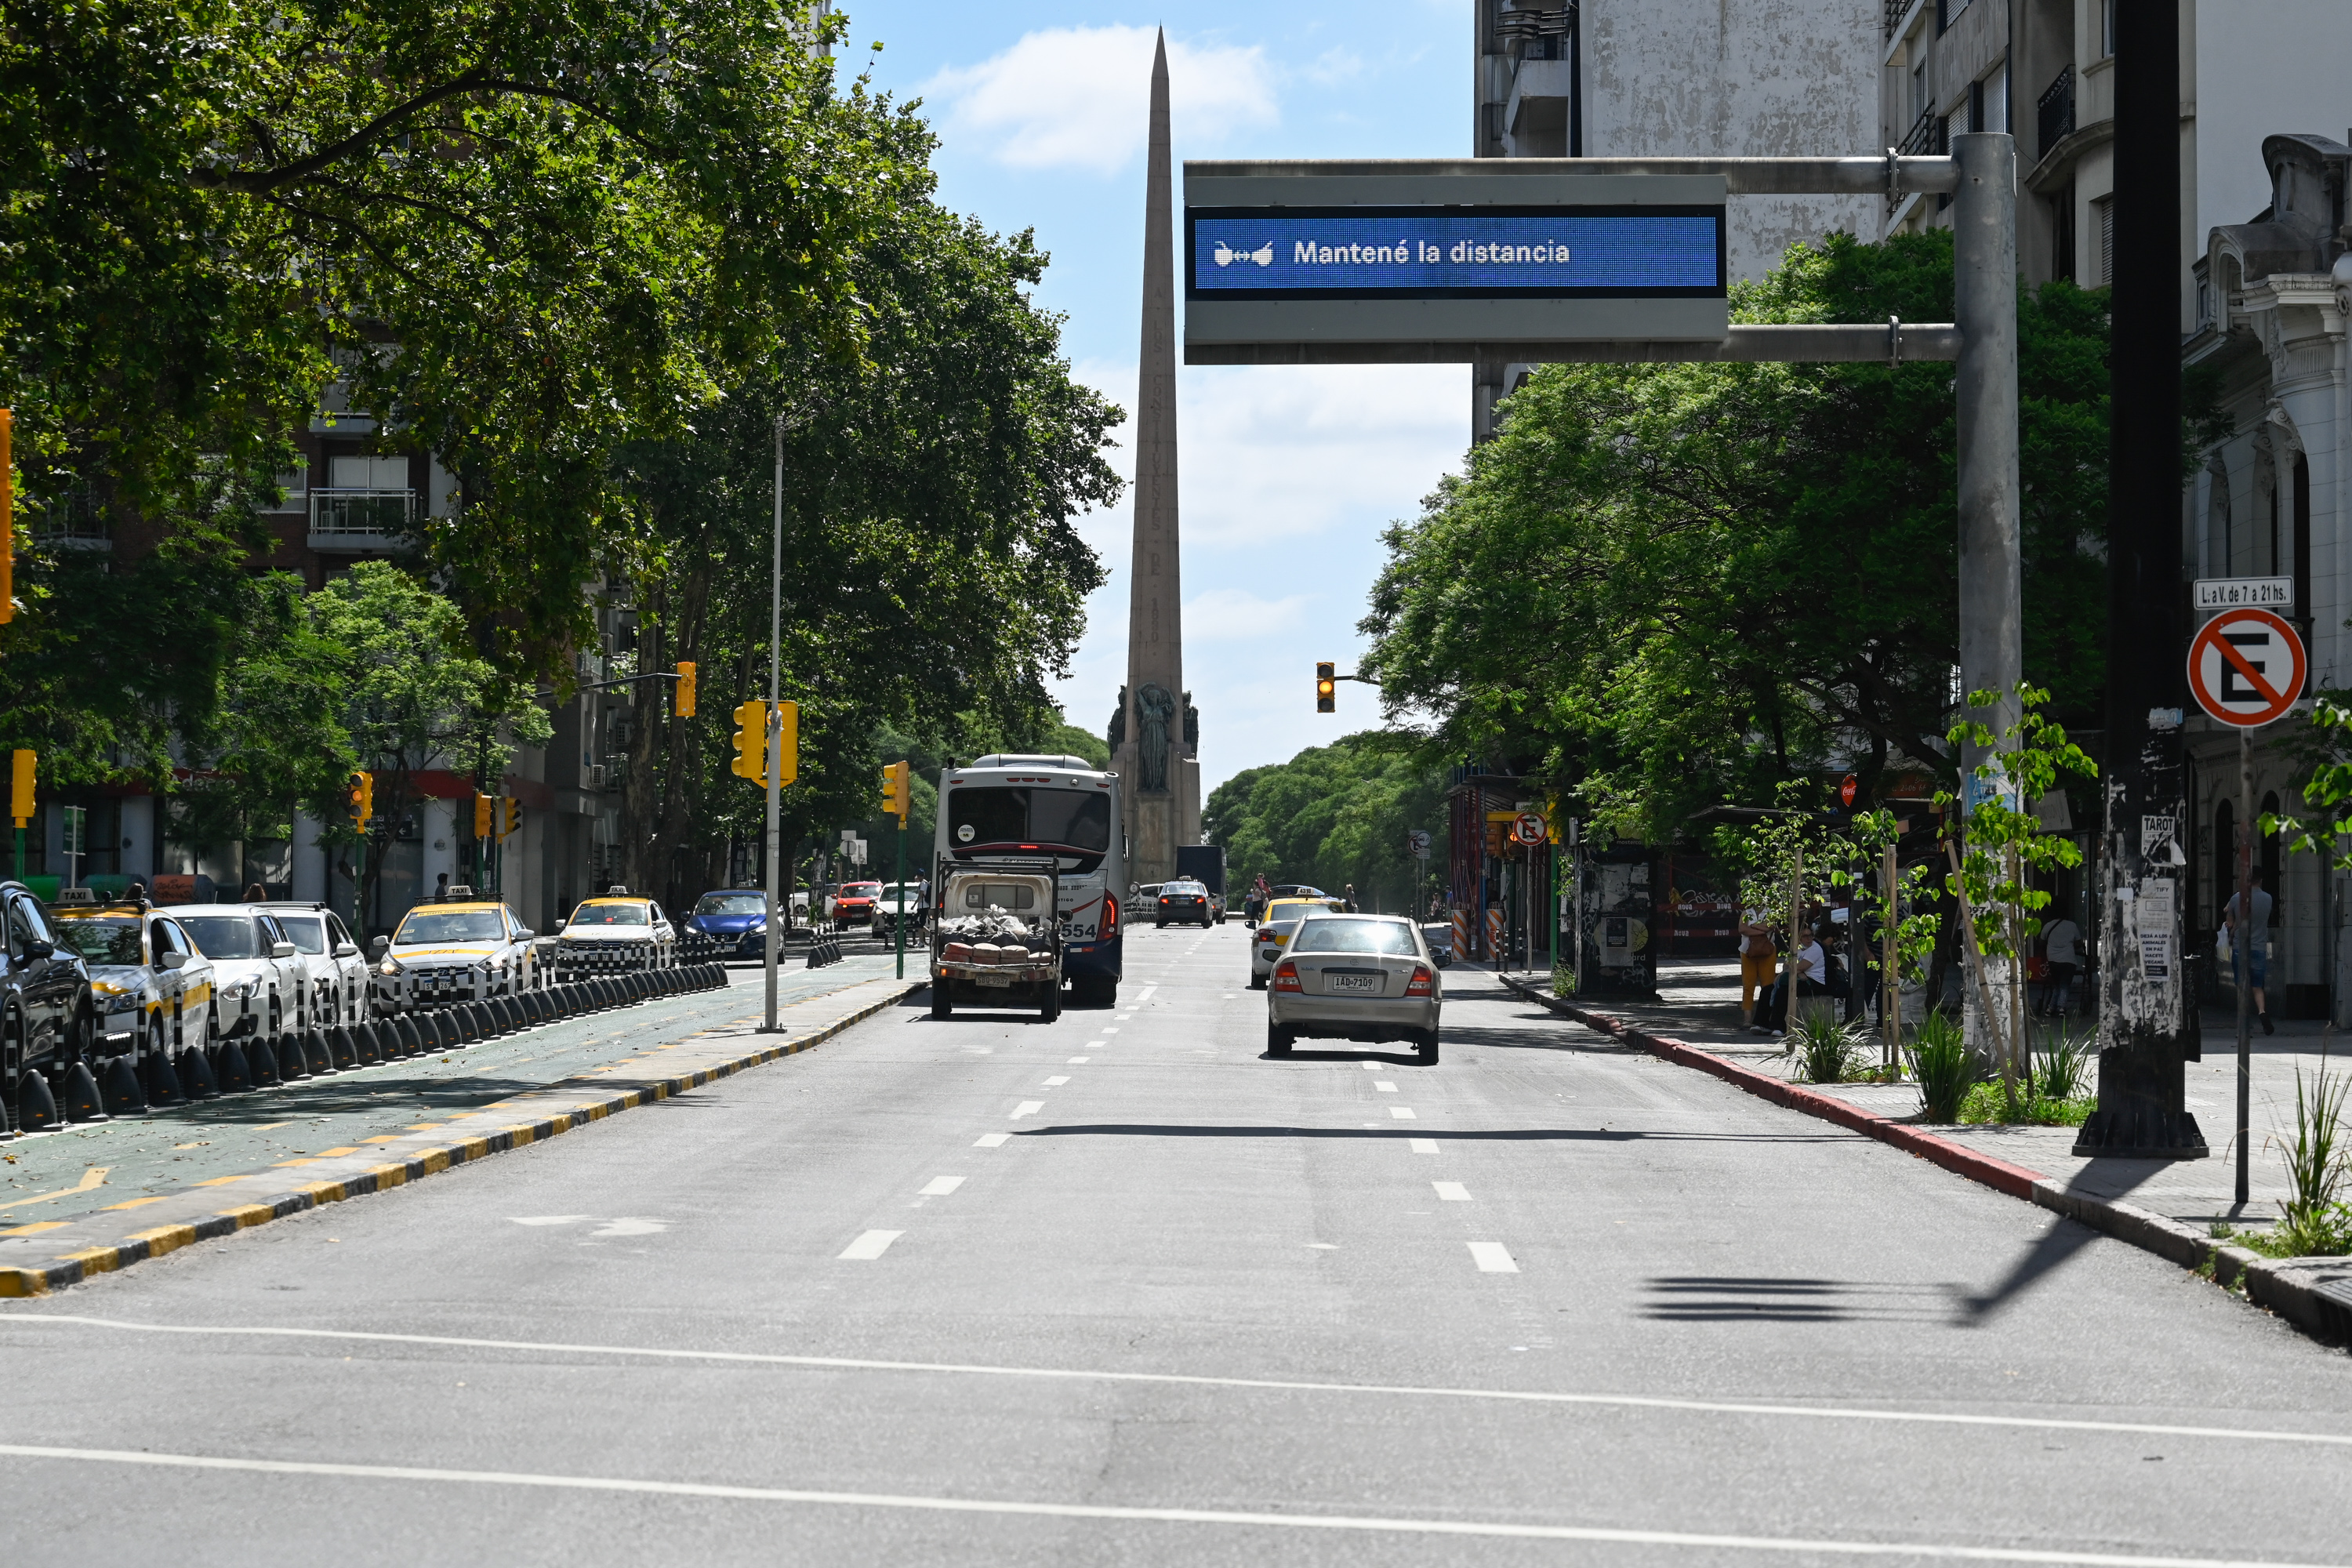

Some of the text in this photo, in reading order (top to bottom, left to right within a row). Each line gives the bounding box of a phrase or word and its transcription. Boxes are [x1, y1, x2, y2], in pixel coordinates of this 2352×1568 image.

[1294, 239, 1570, 264] Mantené la distancia
[2212, 590, 2217, 603] a
[2229, 586, 2238, 602] de
[2243, 586, 2248, 601] 7
[2252, 589, 2256, 601] a
[2261, 585, 2270, 601] 21
[2144, 818, 2173, 831] TAROT
[1353, 978, 1373, 987] 7109
